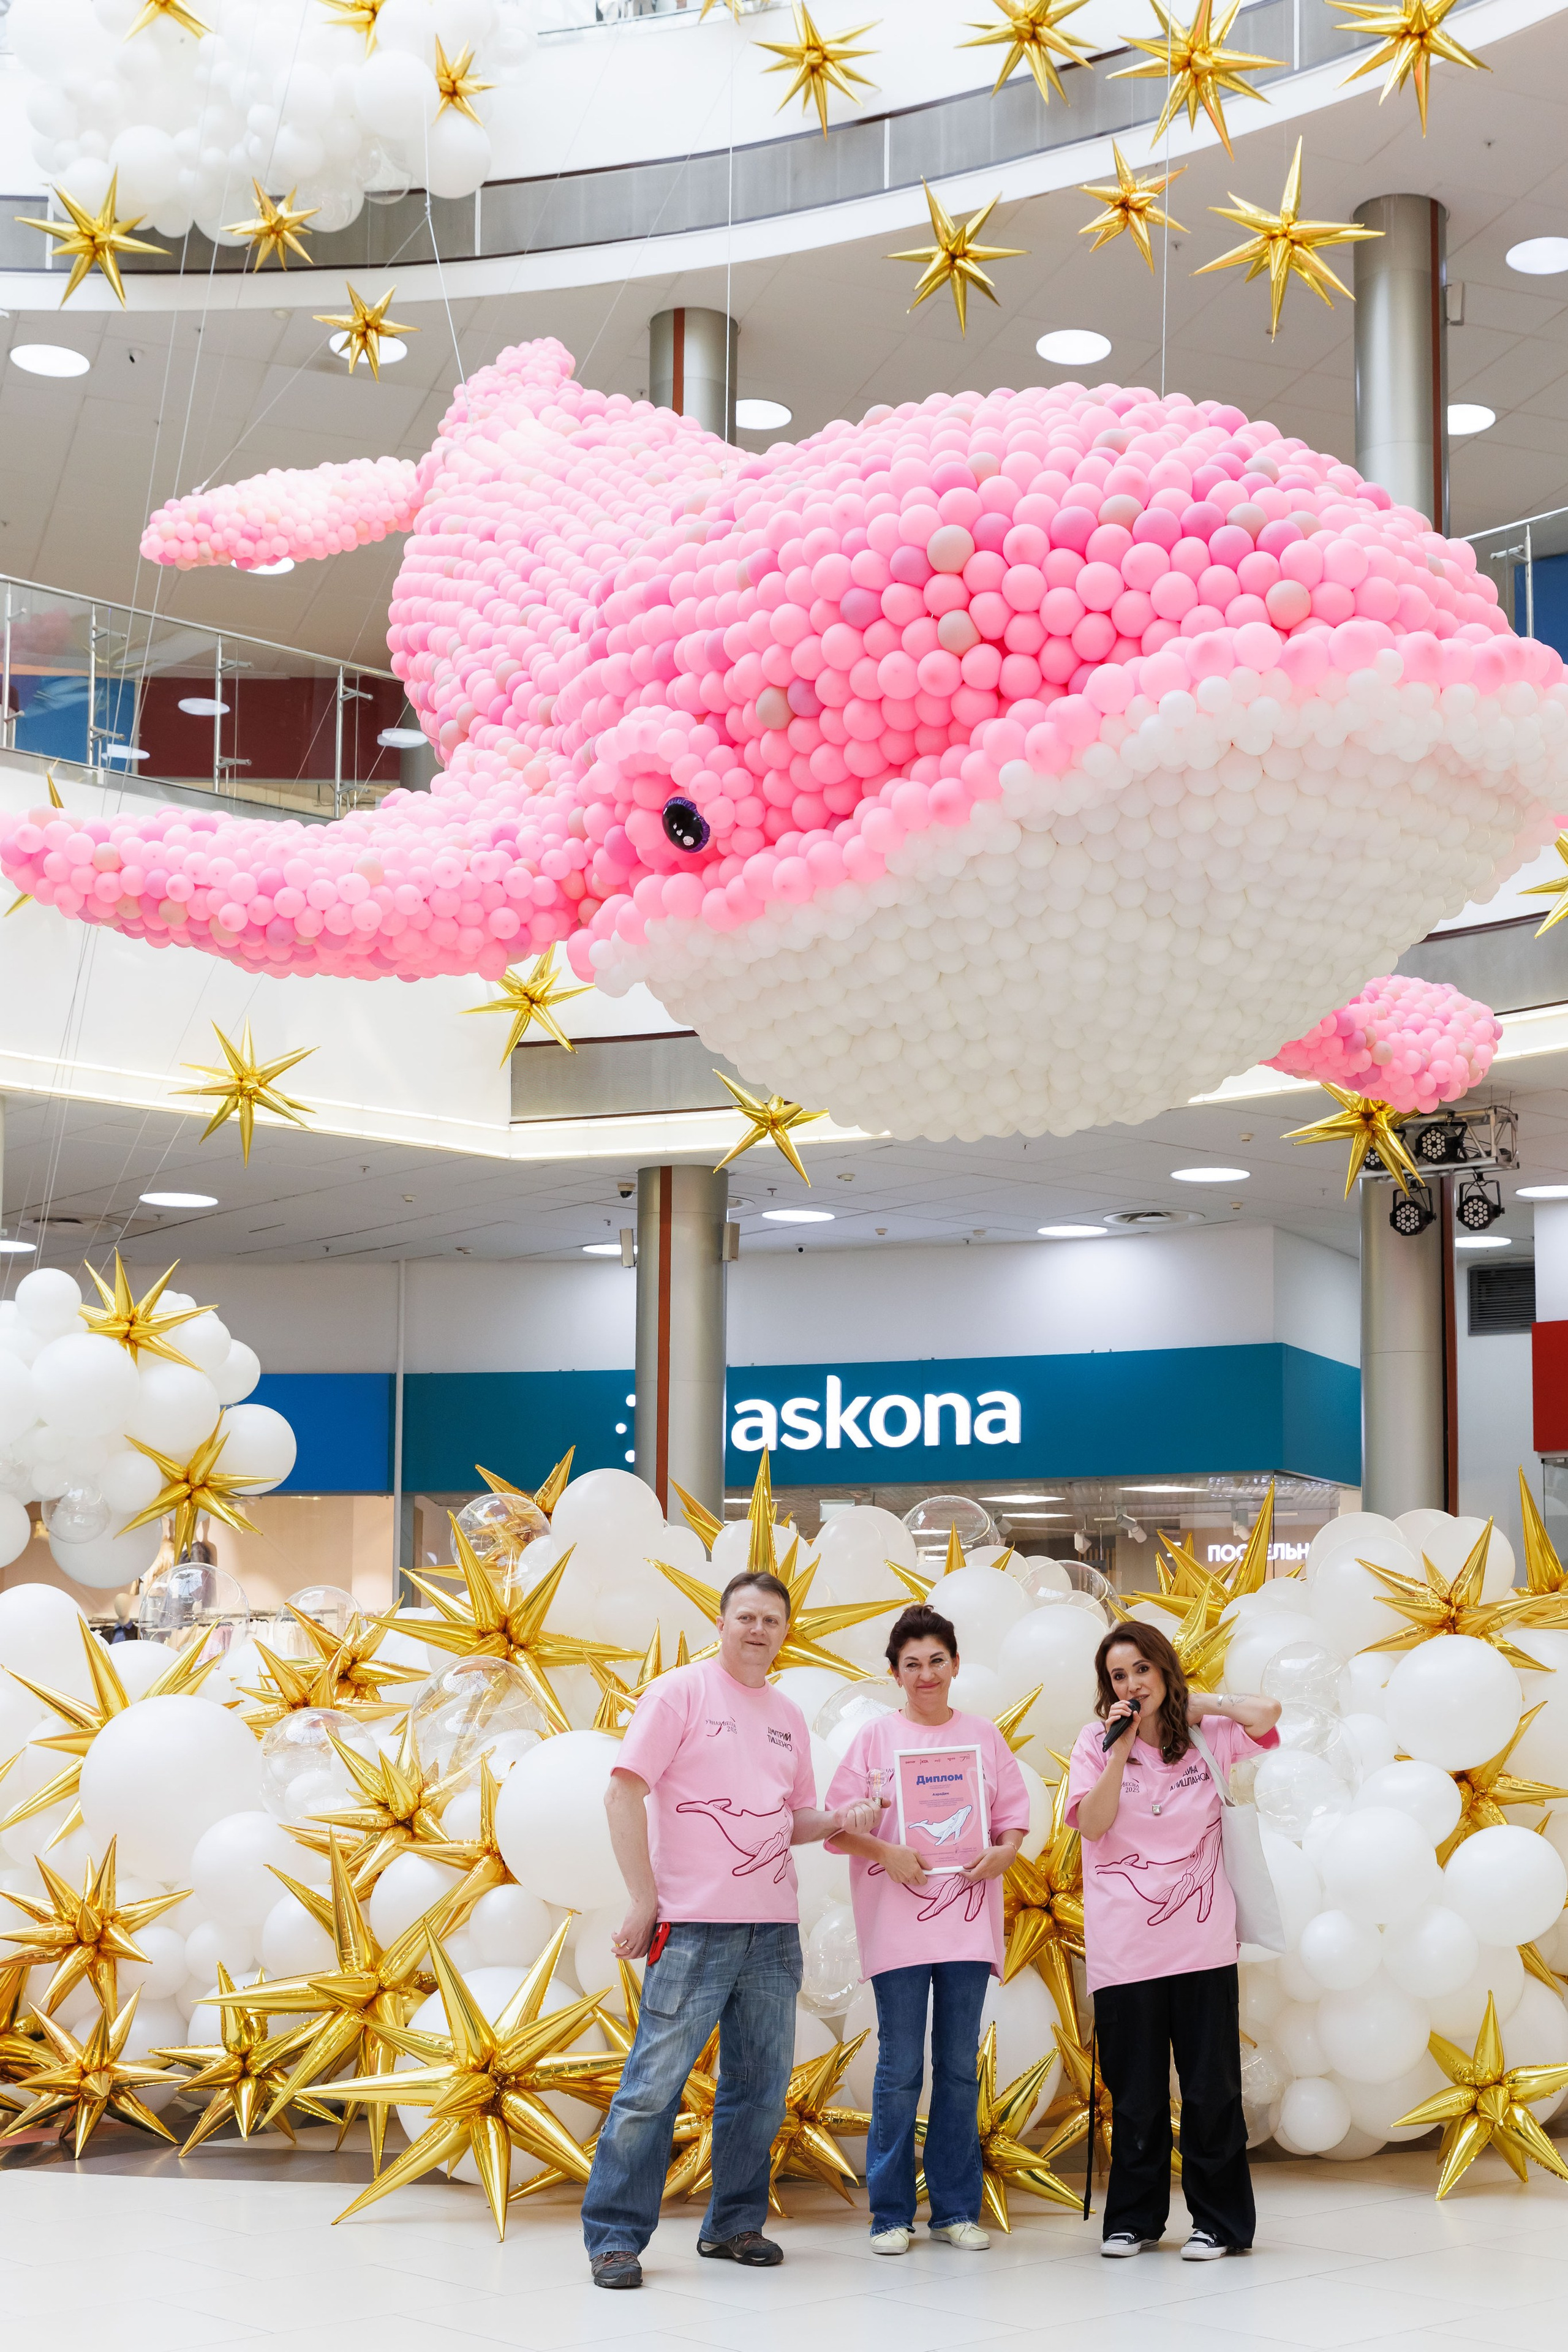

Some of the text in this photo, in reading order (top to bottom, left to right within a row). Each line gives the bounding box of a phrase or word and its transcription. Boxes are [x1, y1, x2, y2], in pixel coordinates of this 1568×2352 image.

[731, 1375, 1021, 1452] askona
[1208, 1543, 1310, 1562] ПОСЕЛЬН
[1182, 1765, 1199, 1777] ДИНА
[916, 1774, 963, 1785] Диплом
